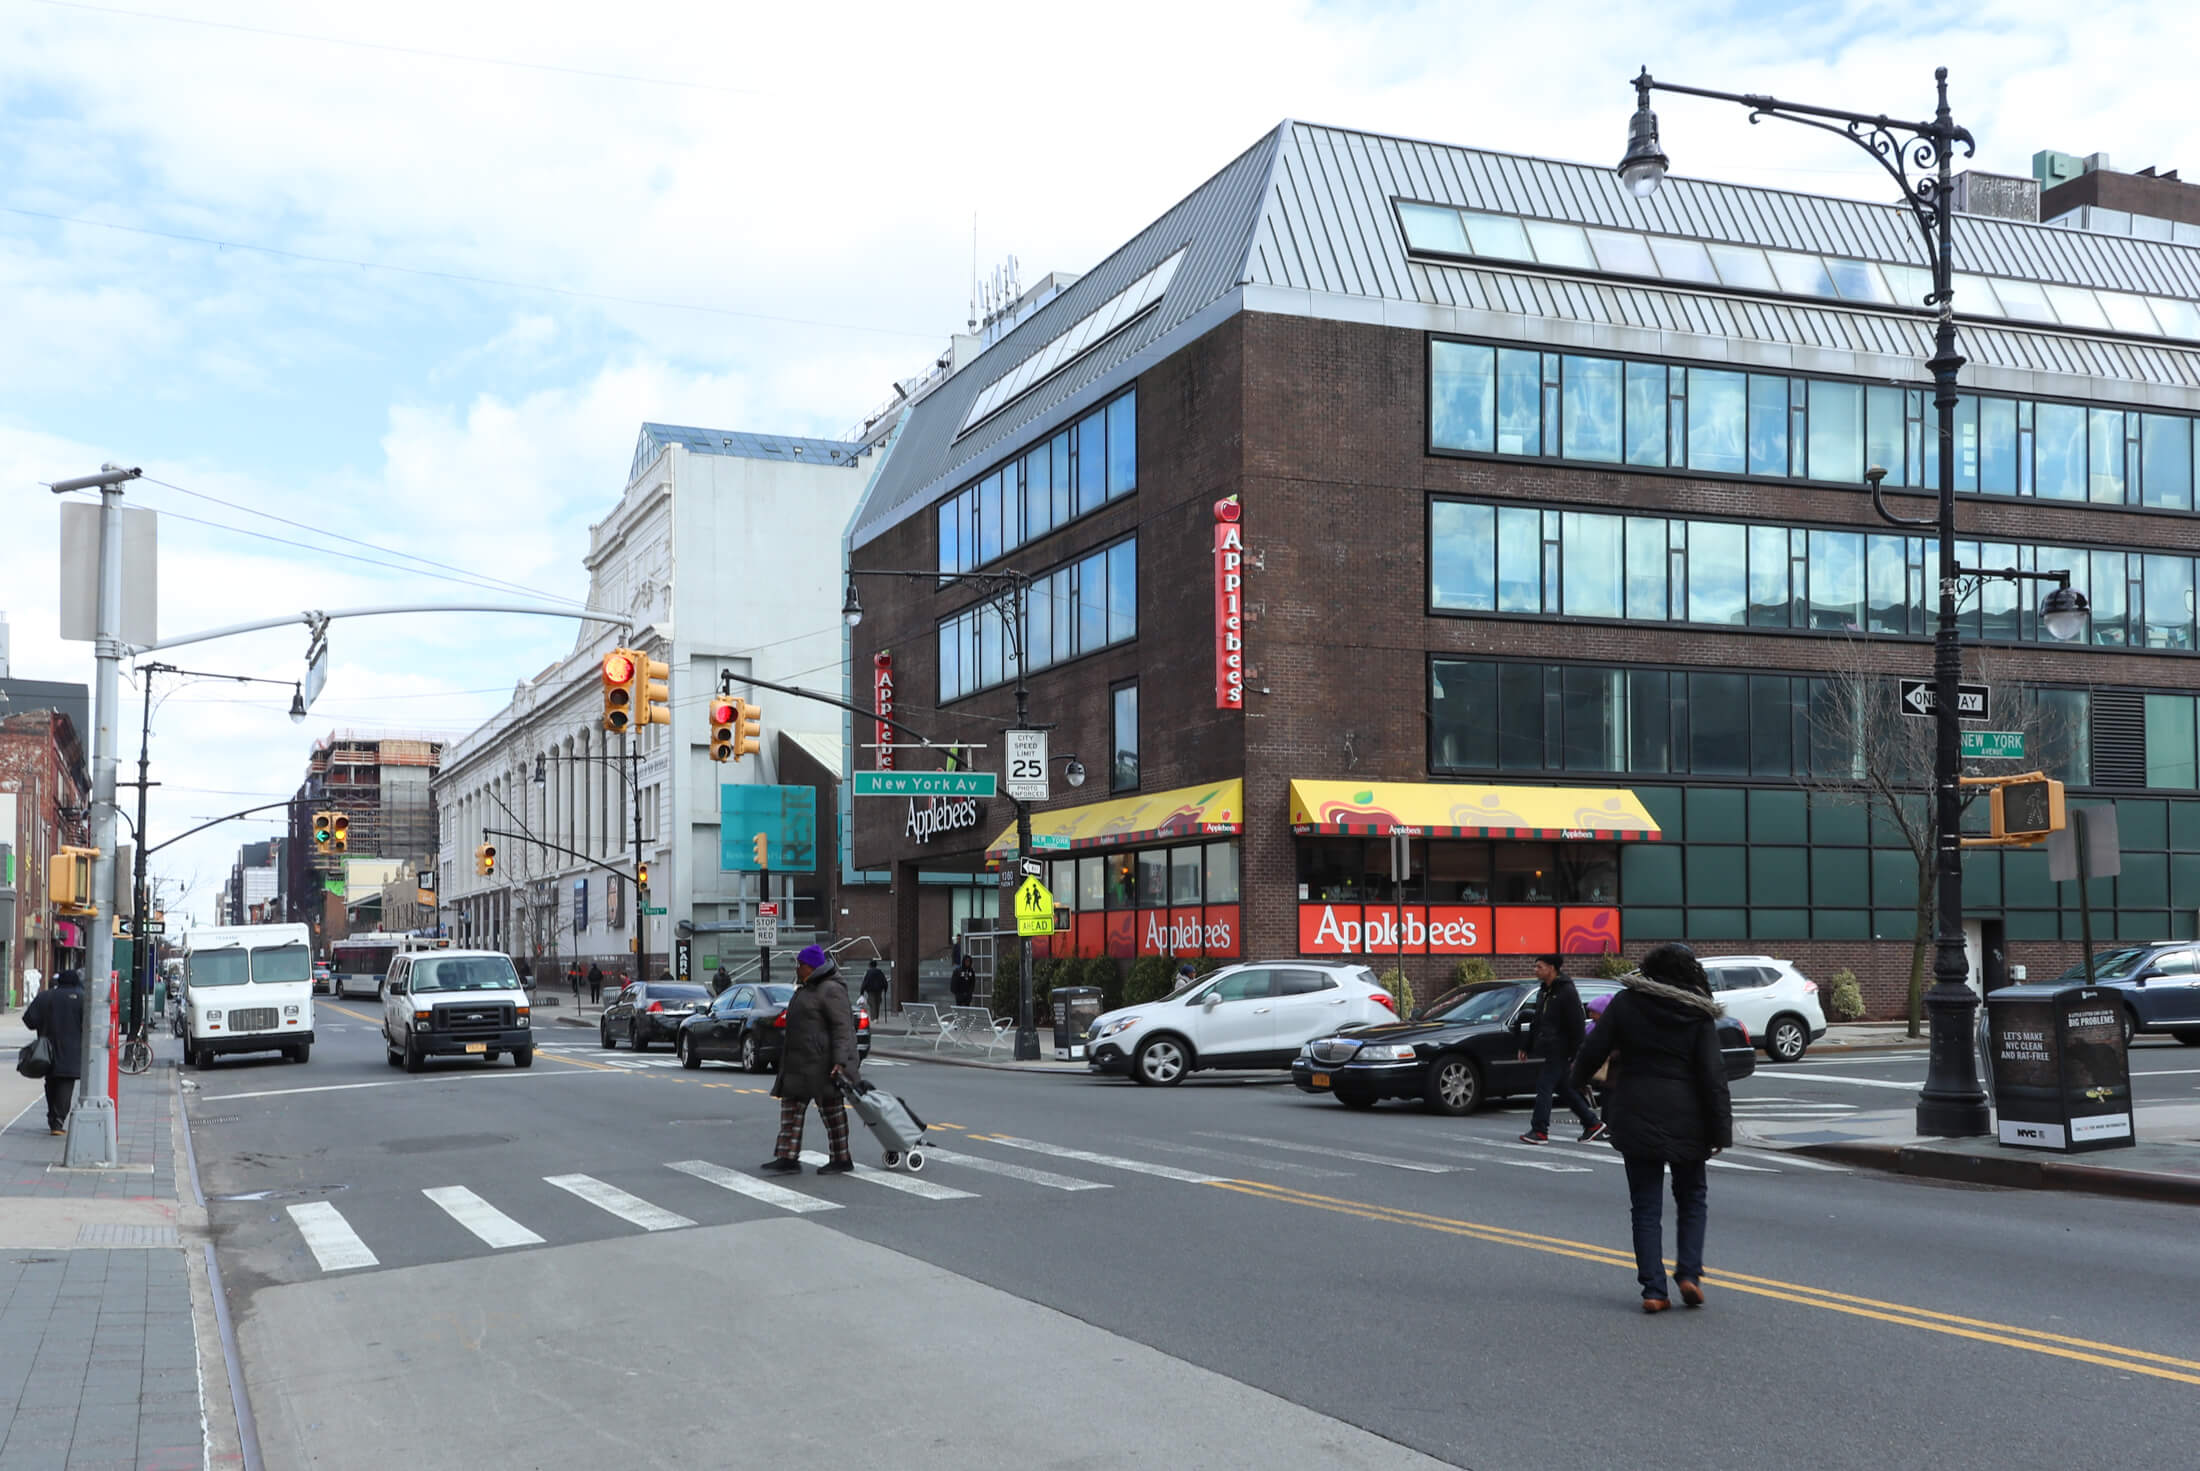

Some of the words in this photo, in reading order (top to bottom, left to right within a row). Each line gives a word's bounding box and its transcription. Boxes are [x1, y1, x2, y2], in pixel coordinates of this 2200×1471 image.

[1222, 528, 1243, 702] Applebee's
[1957, 696, 1978, 709] AY
[1961, 734, 1984, 747] NEW
[1993, 735, 2022, 749] YORK
[1012, 760, 1042, 778] 25
[872, 777, 906, 790] New
[912, 777, 950, 791] York
[955, 778, 977, 791] Av
[905, 796, 977, 844] Applebee's
[1023, 921, 1048, 931] AHEAD
[1314, 905, 1477, 953] Applebee's
[1145, 911, 1231, 957] Applebee's
[679, 946, 688, 975] PARK
[2069, 1018, 2080, 1027] BIG
[2080, 1015, 2115, 1026] PROBLEMS
[2003, 1032, 2022, 1041] LET'S
[2024, 1032, 2044, 1041] MAKE
[2006, 1042, 2019, 1050] NYC
[2021, 1042, 2043, 1050] CLEAN
[2001, 1051, 2015, 1060] AND
[2017, 1052, 2049, 1061] RAT-FREE
[2017, 1128, 2037, 1138] NYC
